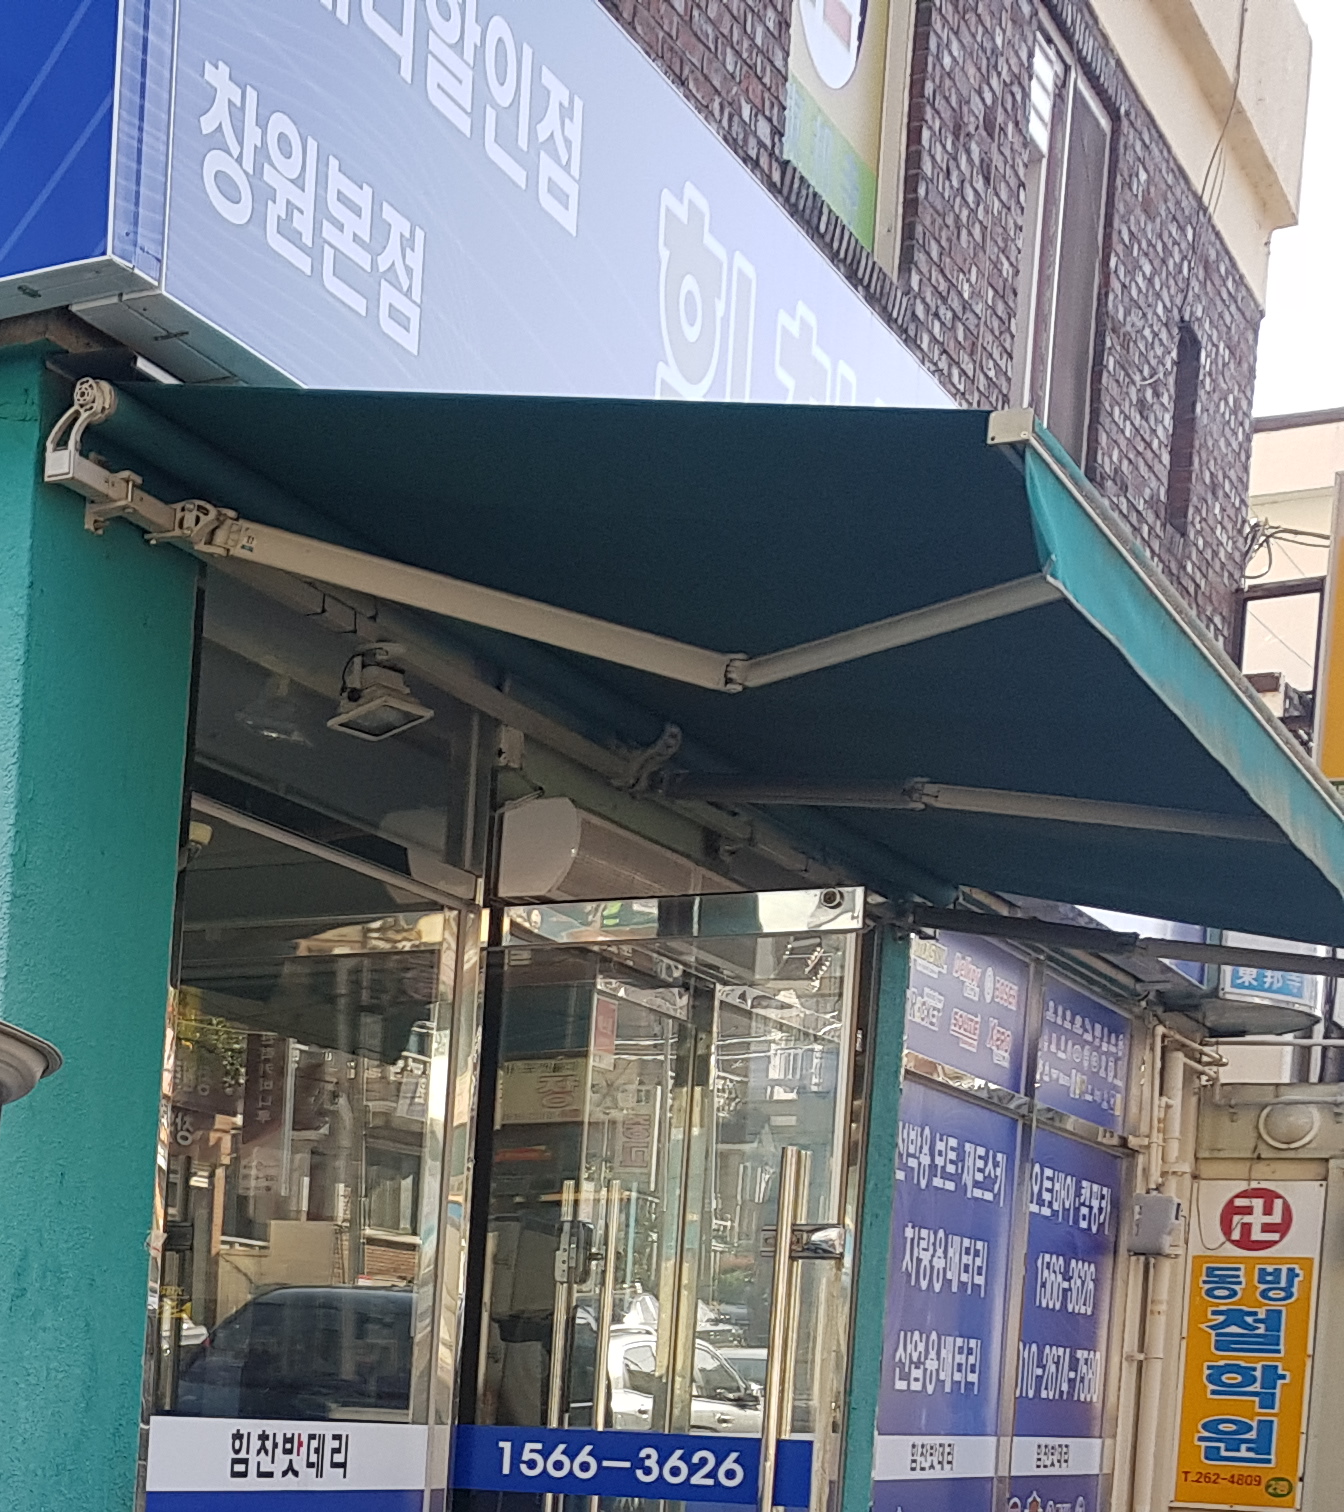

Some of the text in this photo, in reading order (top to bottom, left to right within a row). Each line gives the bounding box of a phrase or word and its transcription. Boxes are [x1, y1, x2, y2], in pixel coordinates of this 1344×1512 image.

[199, 60, 427, 357] 창원본점
[1034, 1253, 1096, 1317] 1566-3626
[1200, 1263, 1303, 1304] 동방
[1196, 1306, 1289, 1466] 철학원
[228, 1428, 350, 1480] 힘찬밧데리
[497, 1440, 746, 1488] 1566-3626
